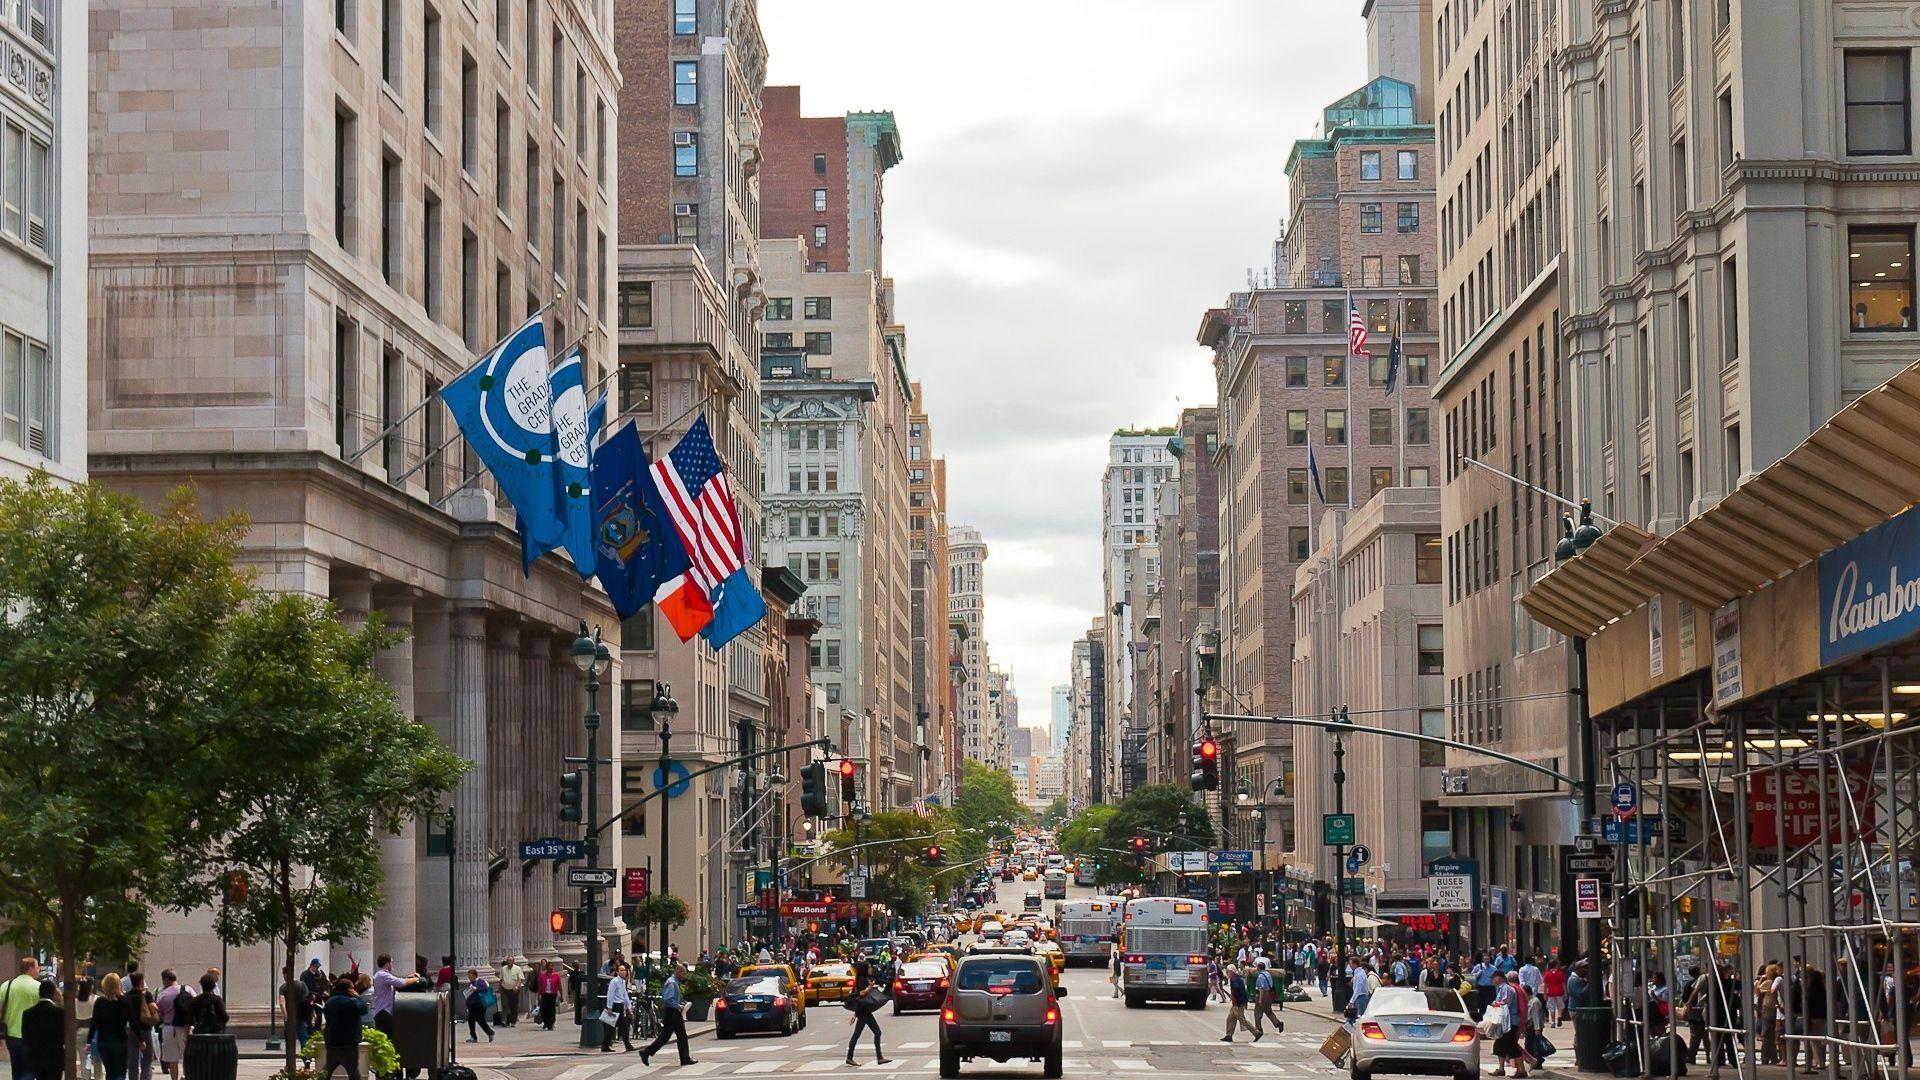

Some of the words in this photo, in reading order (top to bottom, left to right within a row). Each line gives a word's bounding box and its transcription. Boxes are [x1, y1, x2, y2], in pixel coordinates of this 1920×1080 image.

[507, 377, 531, 400] THE
[555, 413, 574, 432] HE
[1830, 561, 1920, 643] Rainbo
[1798, 800, 1815, 809] On
[526, 846, 545, 855] East
[547, 845, 565, 854] 35th
[566, 845, 576, 854] St
[793, 906, 827, 914] McDonal
